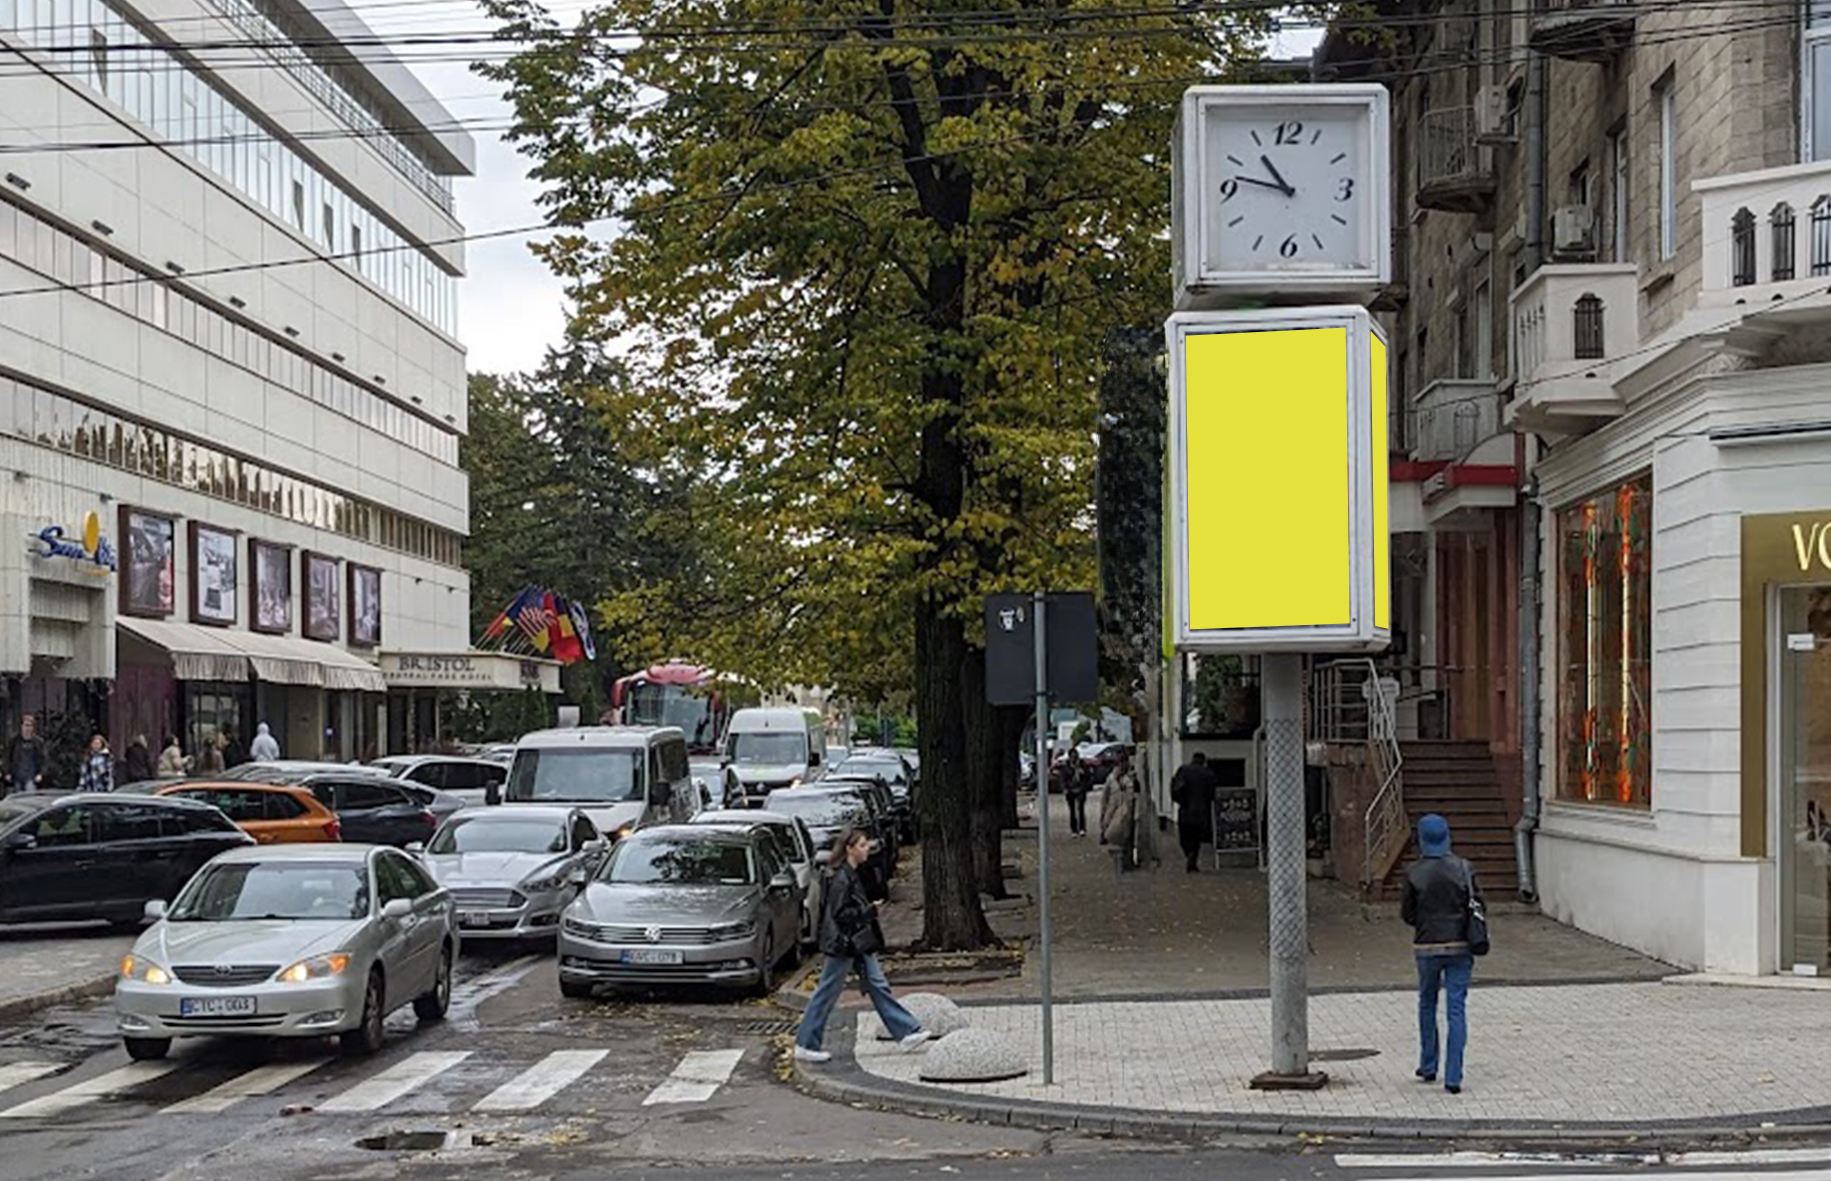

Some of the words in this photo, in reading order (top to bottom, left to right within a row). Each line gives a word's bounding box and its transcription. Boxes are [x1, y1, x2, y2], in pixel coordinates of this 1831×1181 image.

[1273, 121, 1303, 146] 12
[1219, 178, 1239, 205] 9
[1333, 177, 1354, 202] 3
[1279, 232, 1298, 258] 6
[399, 656, 475, 672] BRISTOL
